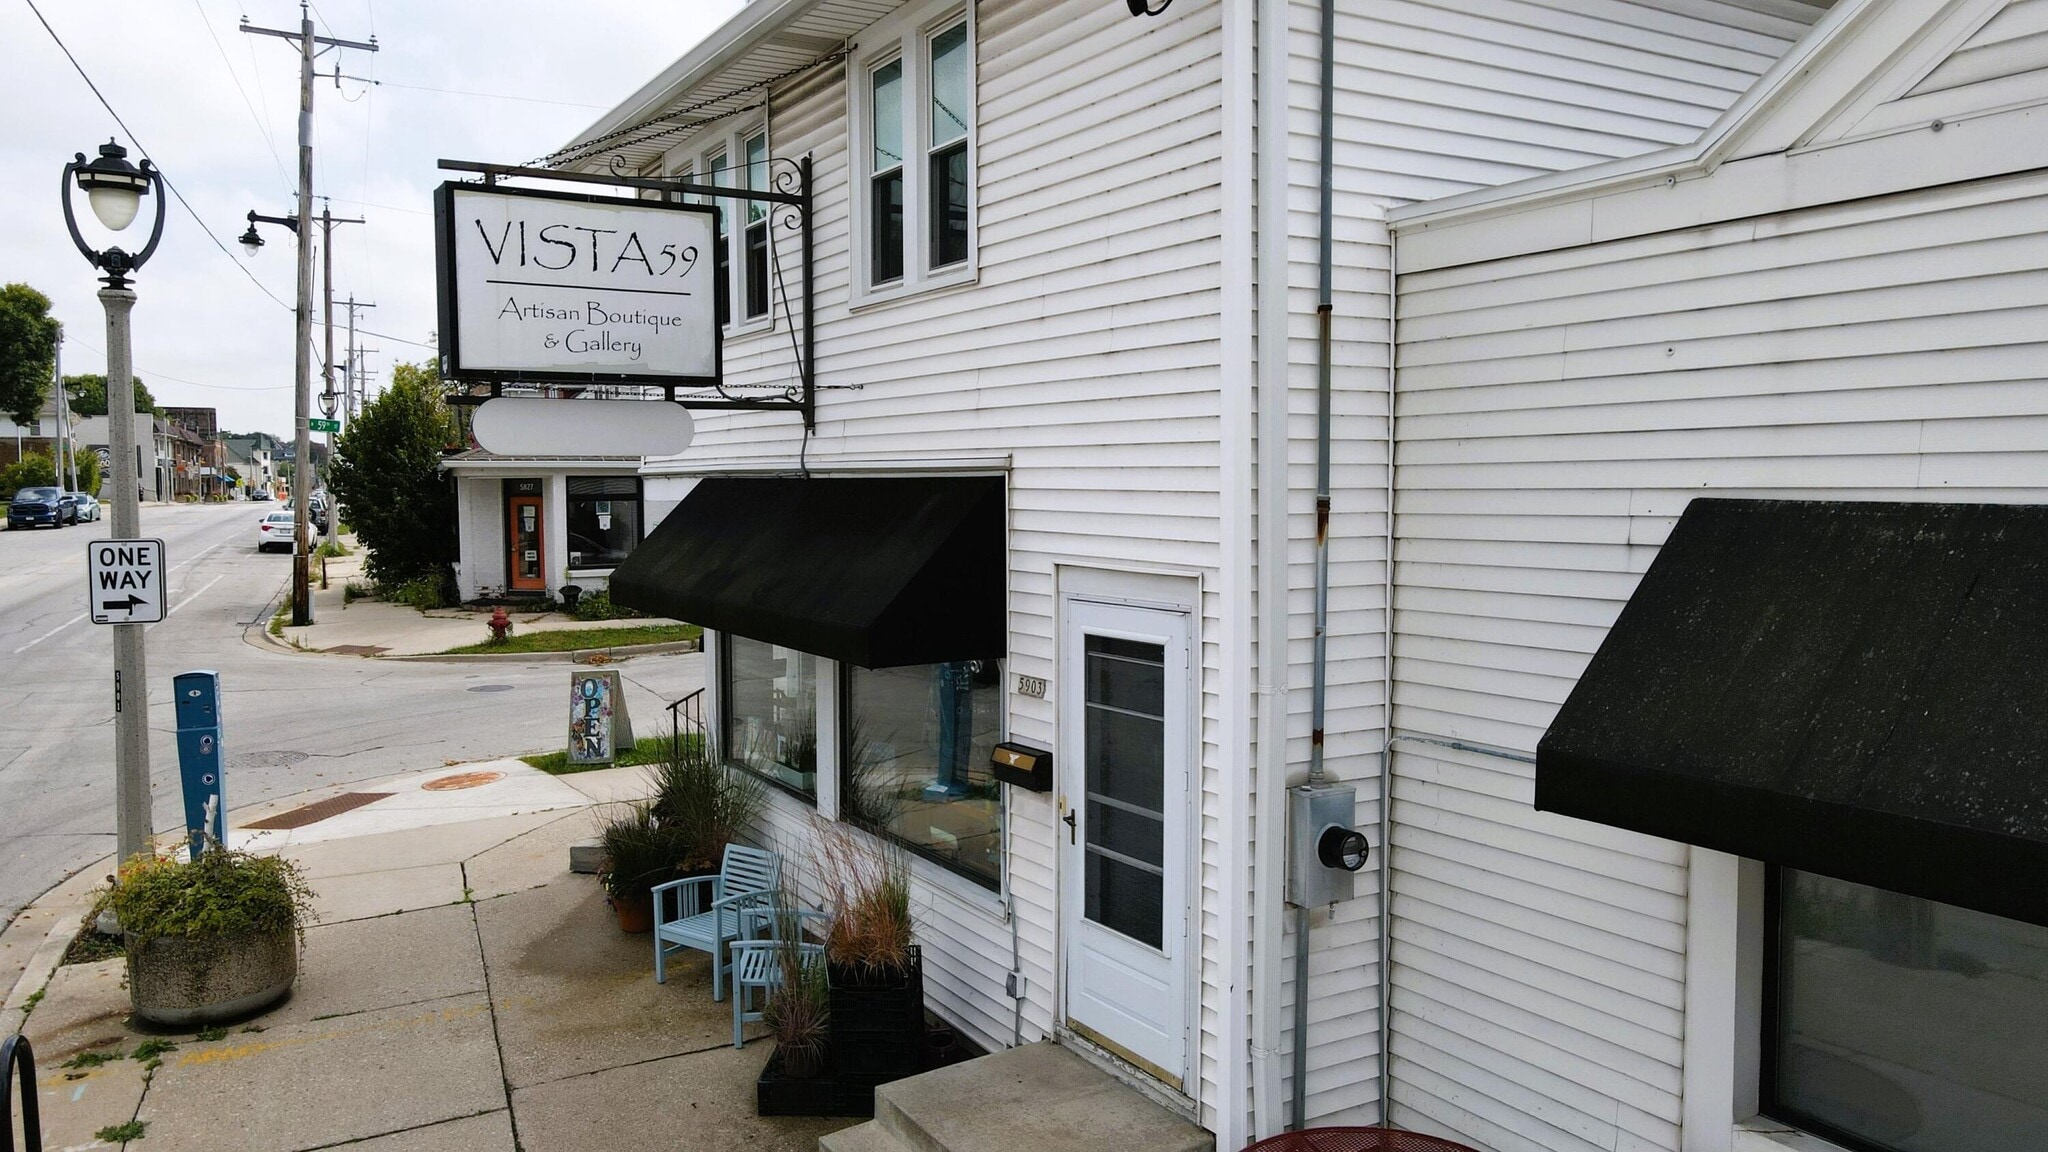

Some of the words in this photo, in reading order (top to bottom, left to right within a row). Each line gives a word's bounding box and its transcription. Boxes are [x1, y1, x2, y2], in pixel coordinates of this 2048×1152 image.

[498, 296, 581, 321] Artisan
[586, 300, 683, 335] Boutique
[543, 333, 560, 349] &
[565, 329, 642, 361] Gallery
[99, 547, 152, 567] ONE
[98, 570, 153, 590] WAY
[1018, 677, 1043, 695] 5903
[580, 678, 605, 758] OPEN
